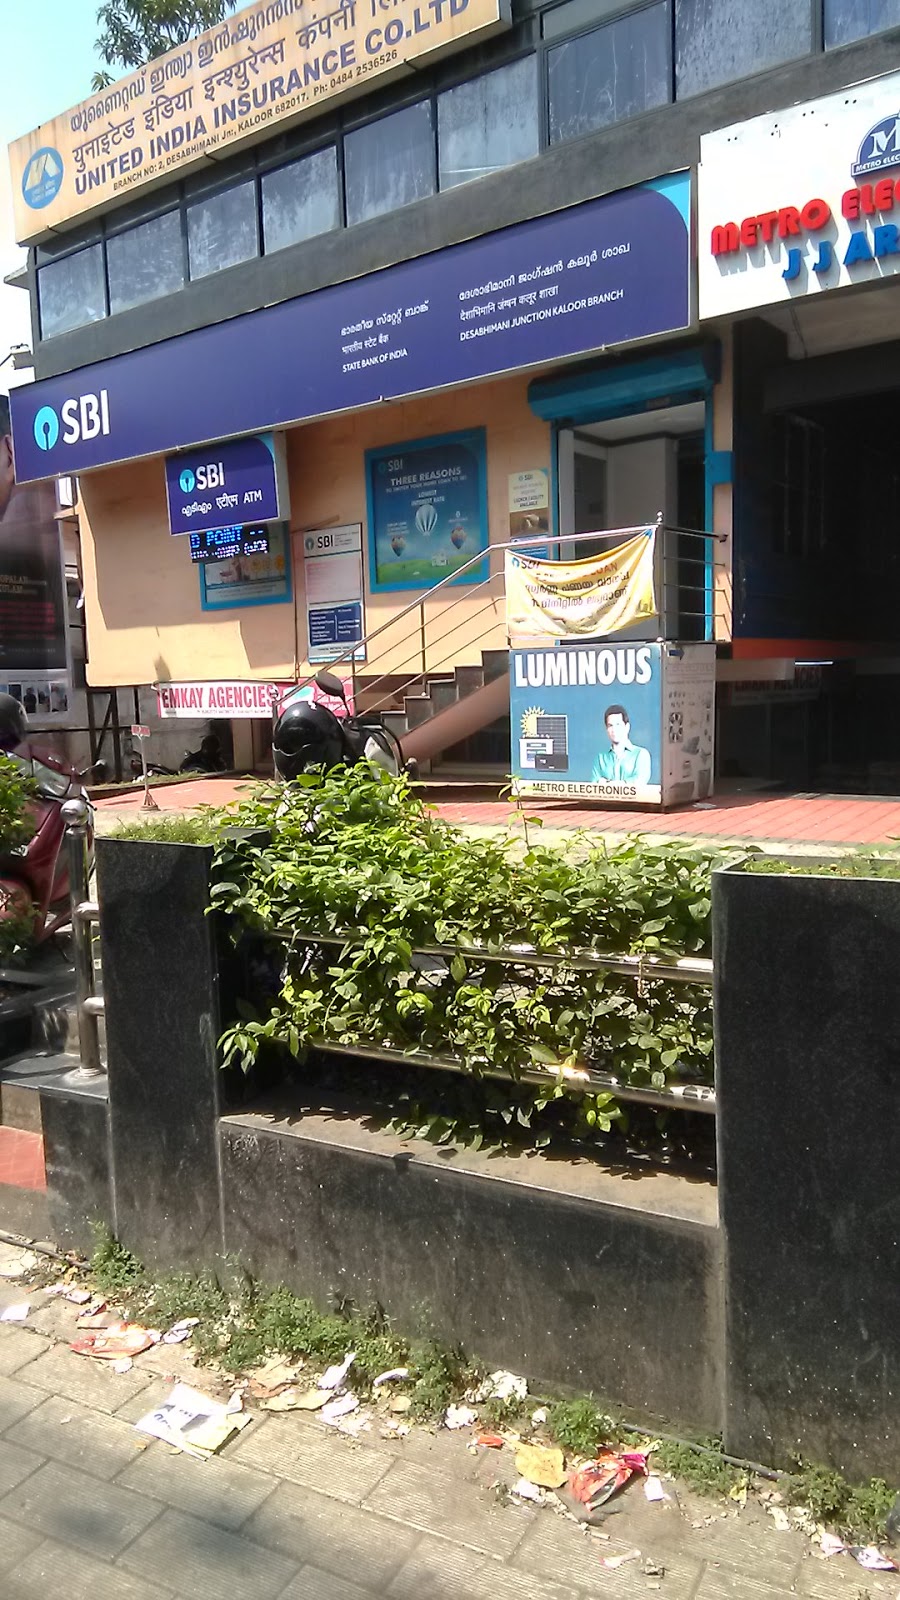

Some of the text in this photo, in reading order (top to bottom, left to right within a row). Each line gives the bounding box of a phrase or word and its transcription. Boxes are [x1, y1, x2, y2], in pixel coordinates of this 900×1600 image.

[72, 117, 135, 172] युनाइटेड
[143, 85, 193, 131] इंडिया
[295, 0, 356, 50] कंपनी
[75, 147, 143, 195] UNITED
[150, 116, 206, 159] INDIA
[213, 40, 356, 128] INSURANCE
[113, 170, 143, 191] BRANCH
[143, 164, 158, 178] NO:
[166, 135, 220, 166] DESABHIMANI
[238, 109, 273, 131] KALOOR
[275, 92, 309, 115] 682017.
[313, 84, 328, 97] Ph:
[330, 71, 353, 89] 0484
[356, 50, 398, 76] 2536526
[856, 158, 881, 173] METRO
[711, 177, 900, 255] METRO ELE
[567, 250, 597, 269] കലൂർ
[602, 243, 631, 259] ശാഖ
[539, 285, 559, 299] शाखा
[459, 289, 624, 342] DESABHIMANI JUNCTION KALOOR BRANCH
[342, 348, 408, 373] STATE BANK OF INDIA
[61, 389, 110, 445] SBI
[195, 462, 225, 490] SBI
[388, 458, 403, 472] SBI
[390, 467, 461, 486] THREE REASONS
[215, 493, 239, 511] एटीएम
[243, 490, 262, 504] ATM
[206, 525, 243, 546] POINT
[317, 534, 334, 549] SBI
[514, 647, 652, 687] LUMINOUS
[162, 684, 273, 708] EMKAY AGENCIES
[533, 782, 636, 796] METRO ELECTRONICS
